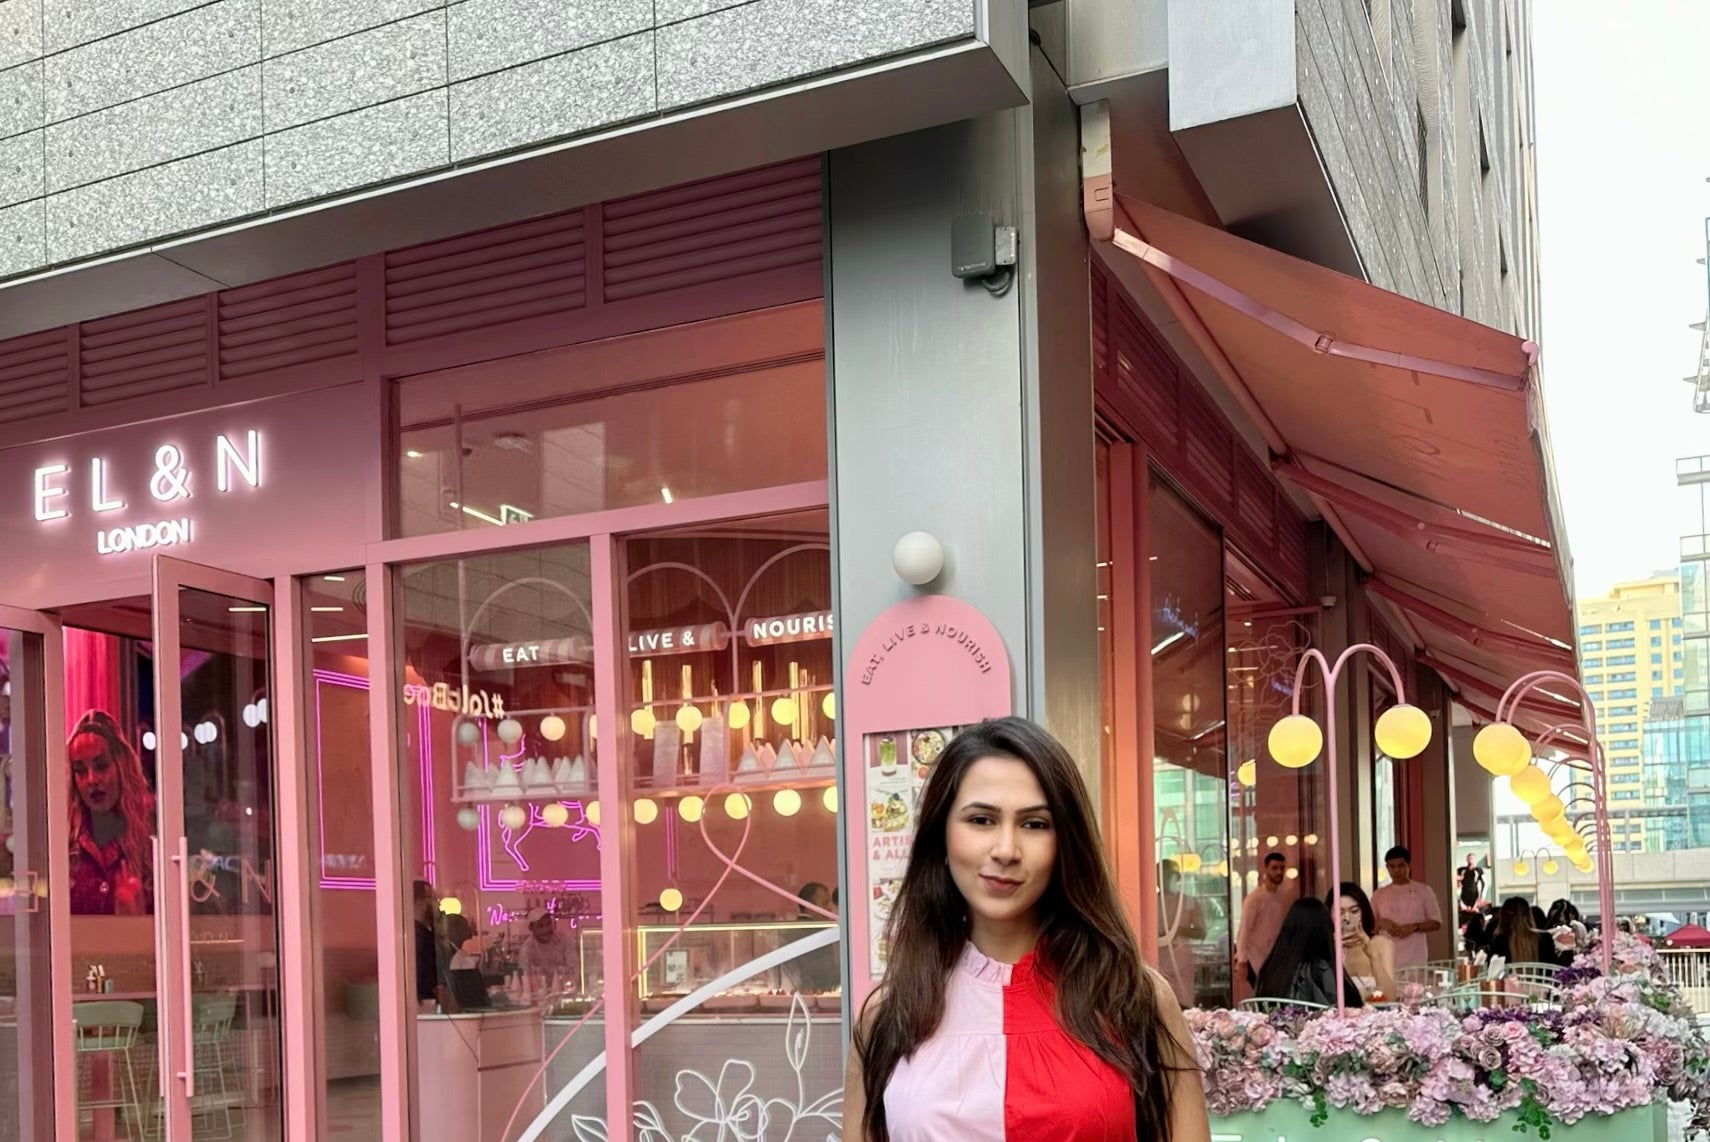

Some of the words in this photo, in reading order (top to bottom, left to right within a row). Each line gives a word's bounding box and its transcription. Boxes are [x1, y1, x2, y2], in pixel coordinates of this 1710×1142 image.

[98, 518, 193, 554] LONDON
[503, 645, 540, 663] EAT
[628, 632, 674, 652] LIVE
[682, 630, 696, 646] &
[753, 614, 834, 639] NOURIS
[882, 625, 916, 652] LIVE
[935, 624, 992, 674] NOURISH
